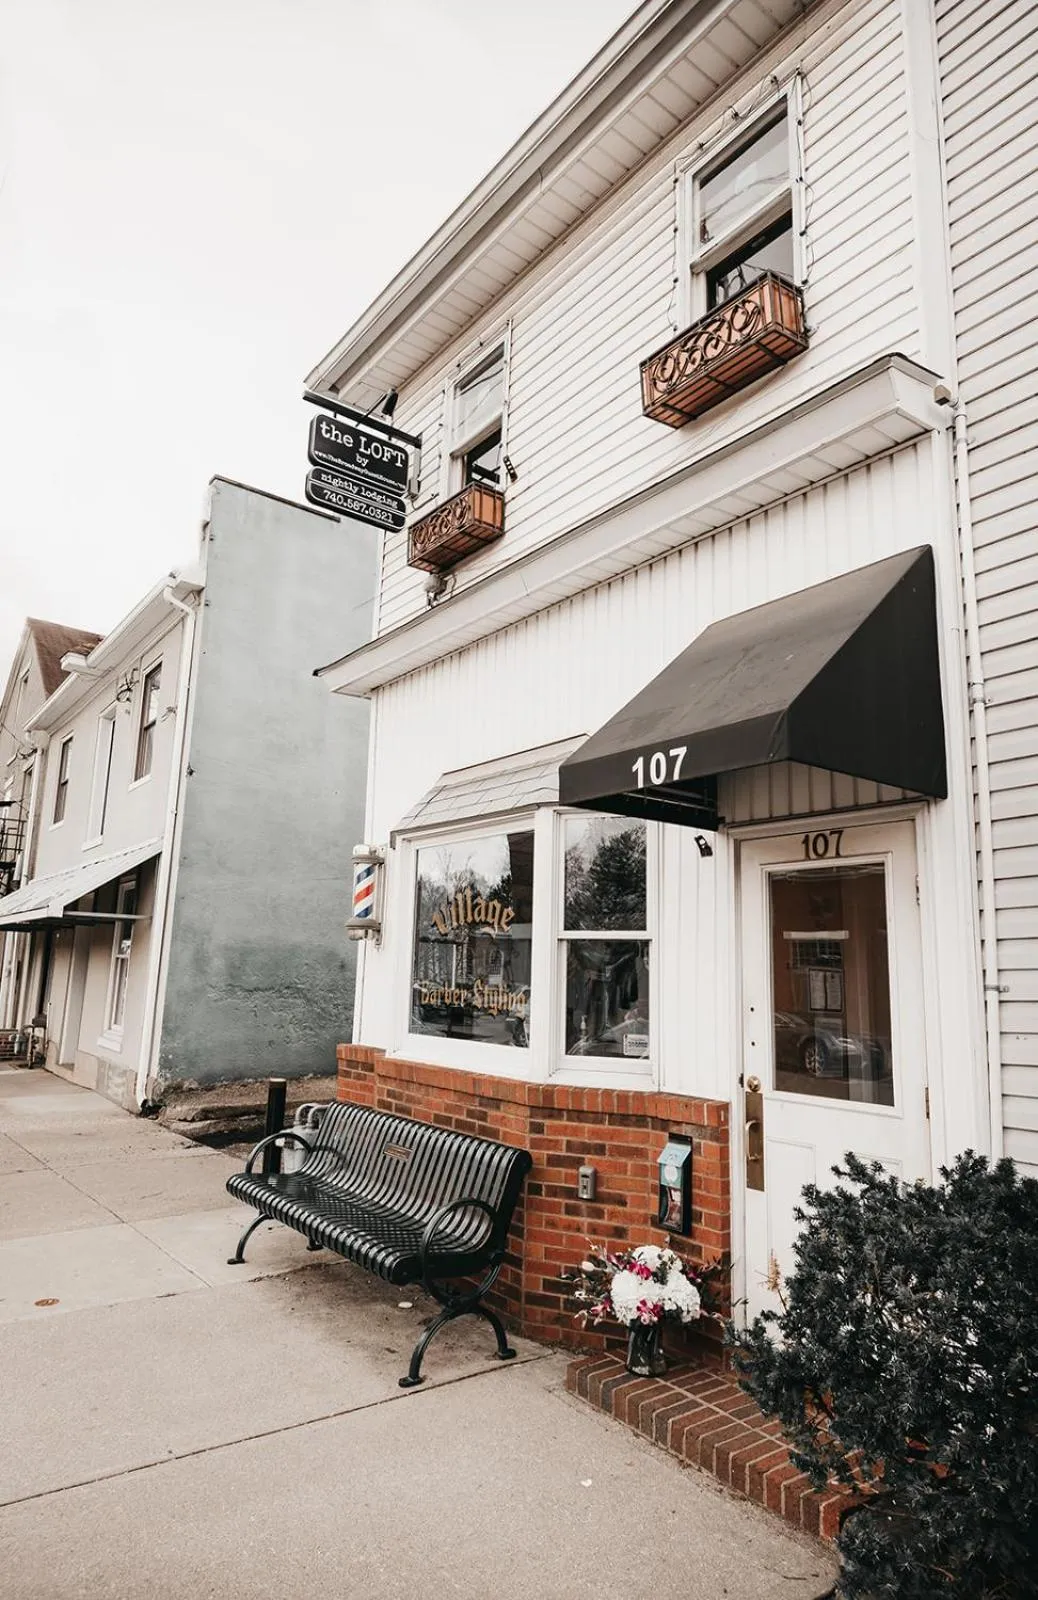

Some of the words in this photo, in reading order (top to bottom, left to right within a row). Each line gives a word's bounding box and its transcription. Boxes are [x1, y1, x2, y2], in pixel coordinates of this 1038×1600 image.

[320, 421, 354, 447] the
[359, 436, 406, 467] LOFT
[356, 453, 369, 466] by
[321, 473, 359, 494] nightly
[361, 487, 399, 509] lodging
[323, 490, 394, 523] 740.587.0321
[631, 746, 688, 789] 107
[801, 830, 844, 860] 107
[431, 887, 515, 938] Village
